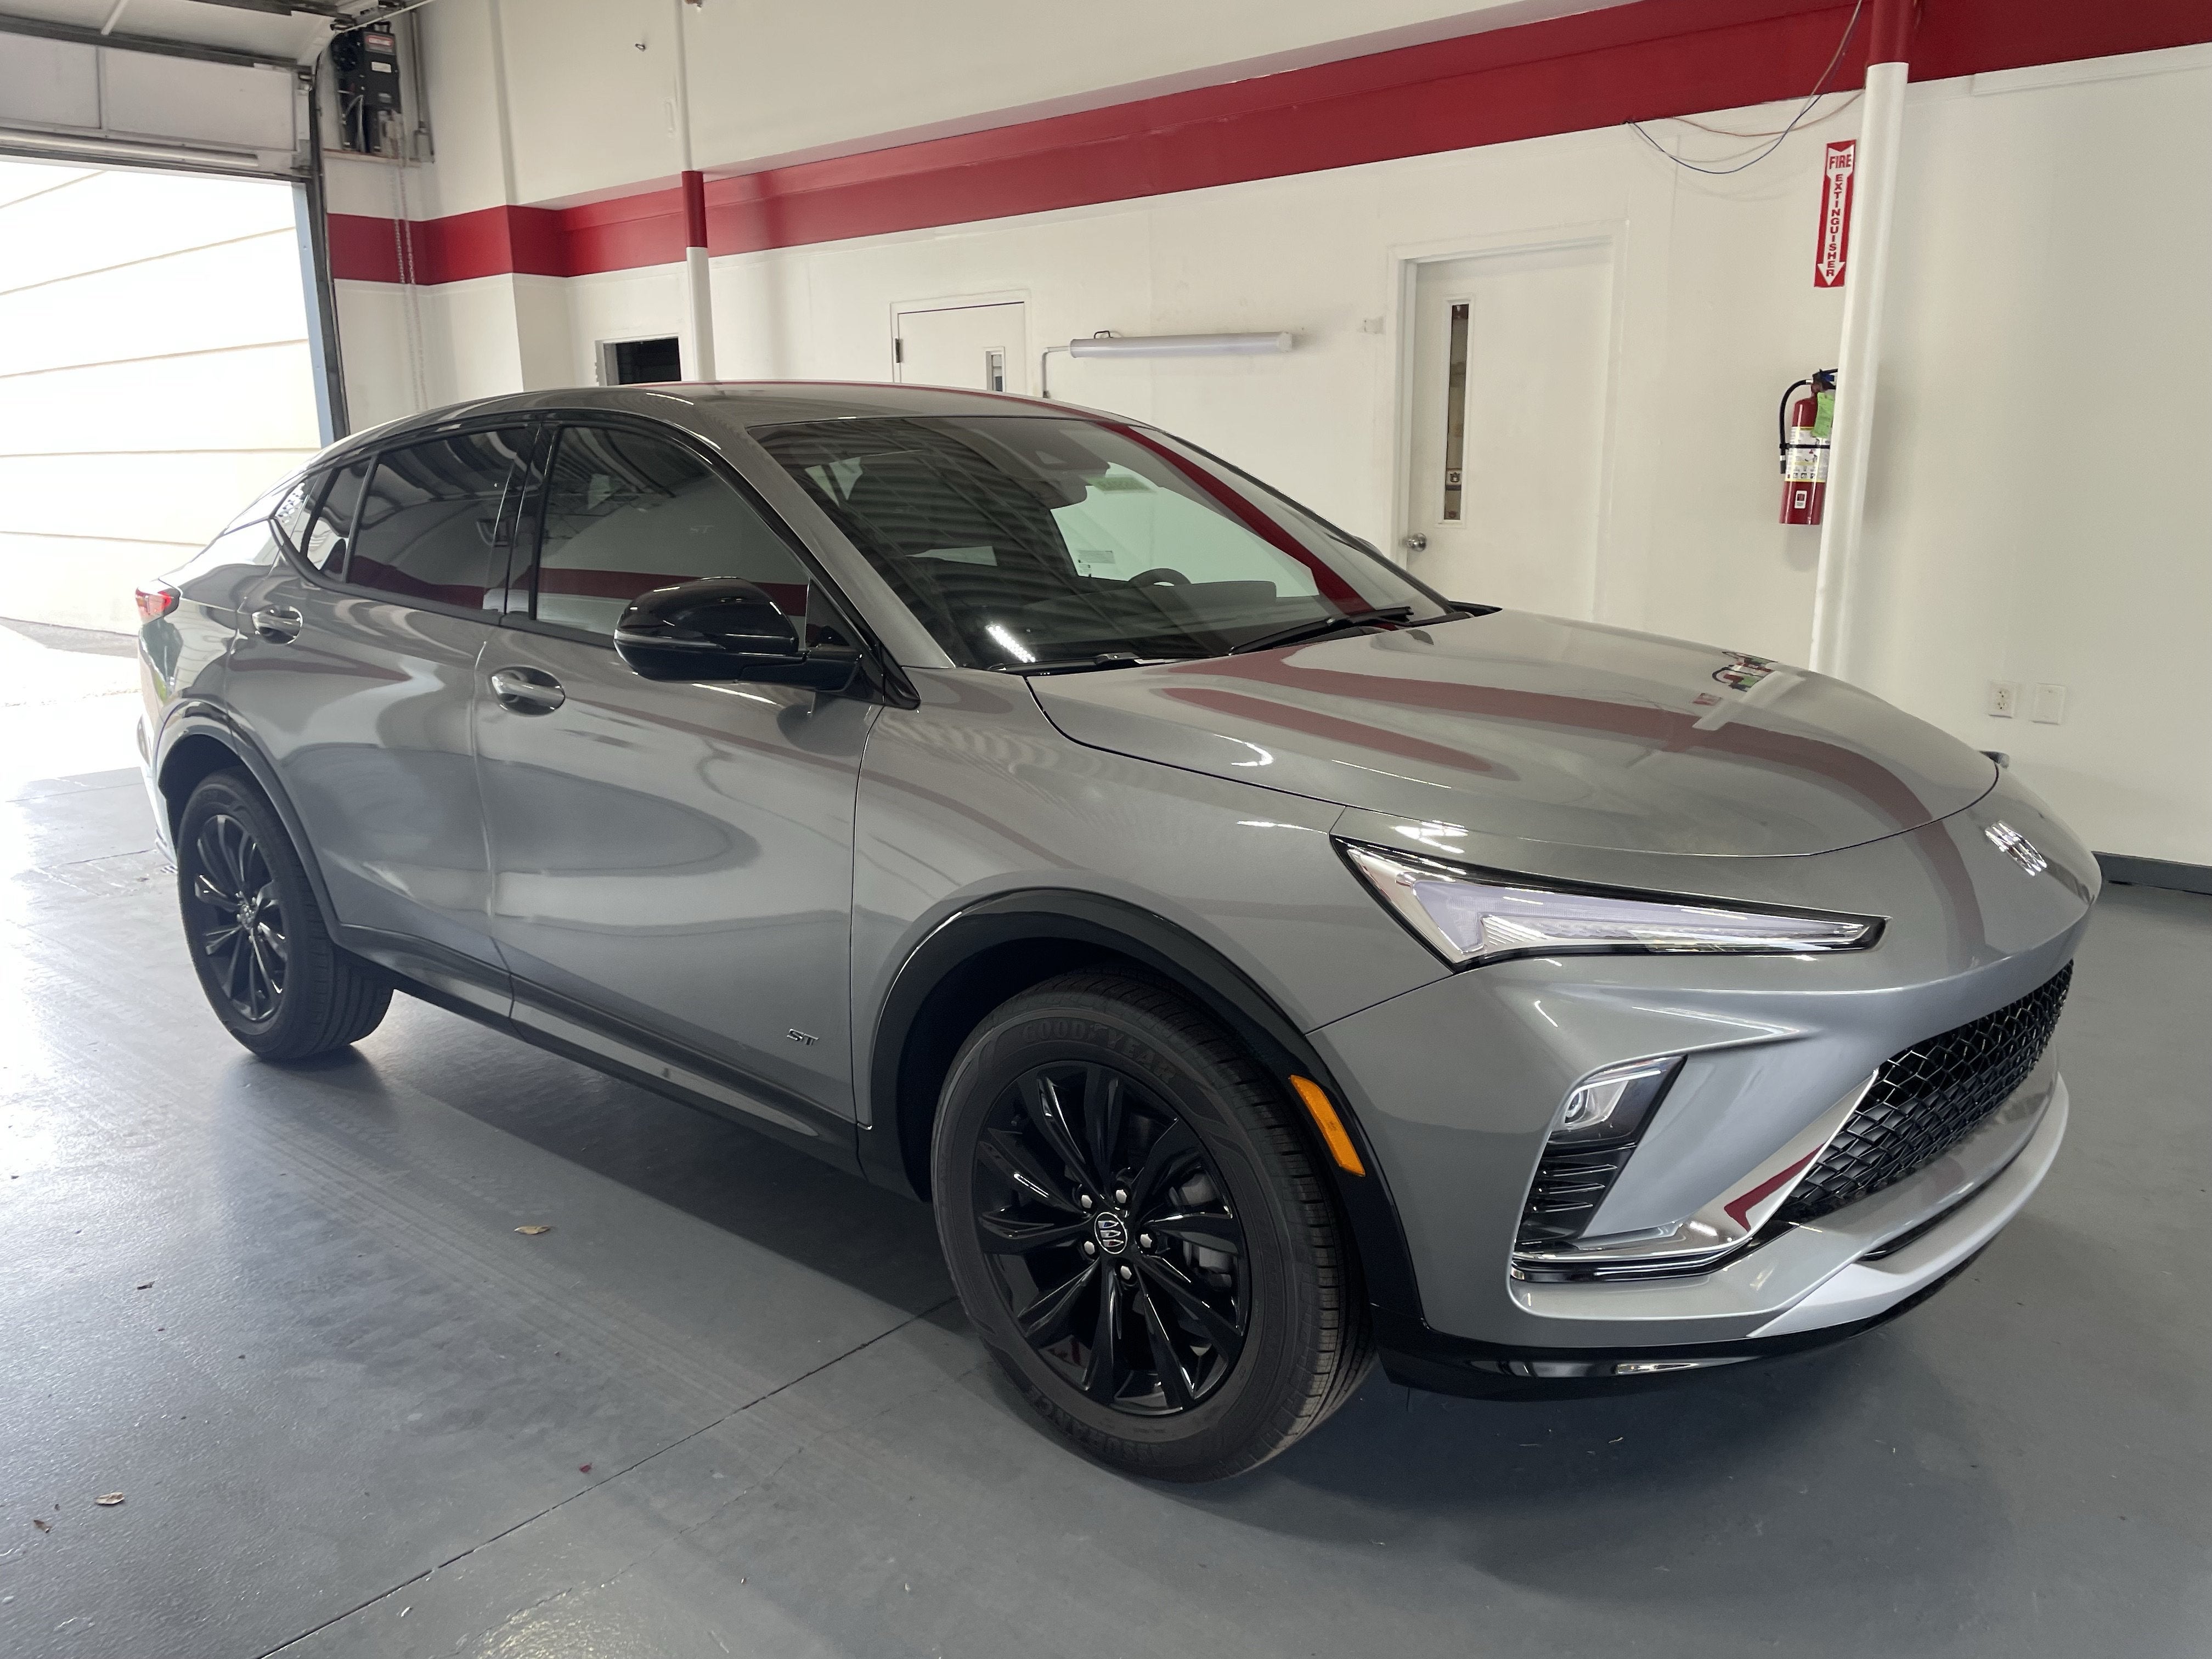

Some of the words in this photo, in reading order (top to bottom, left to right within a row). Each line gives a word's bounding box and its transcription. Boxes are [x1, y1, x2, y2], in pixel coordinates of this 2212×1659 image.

[1829, 154, 1852, 170] FIRE
[1826, 174, 1843, 276] EXTINGUISHER
[786, 1028, 819, 1046] ST
[1022, 1020, 1176, 1085] GOODYEAR
